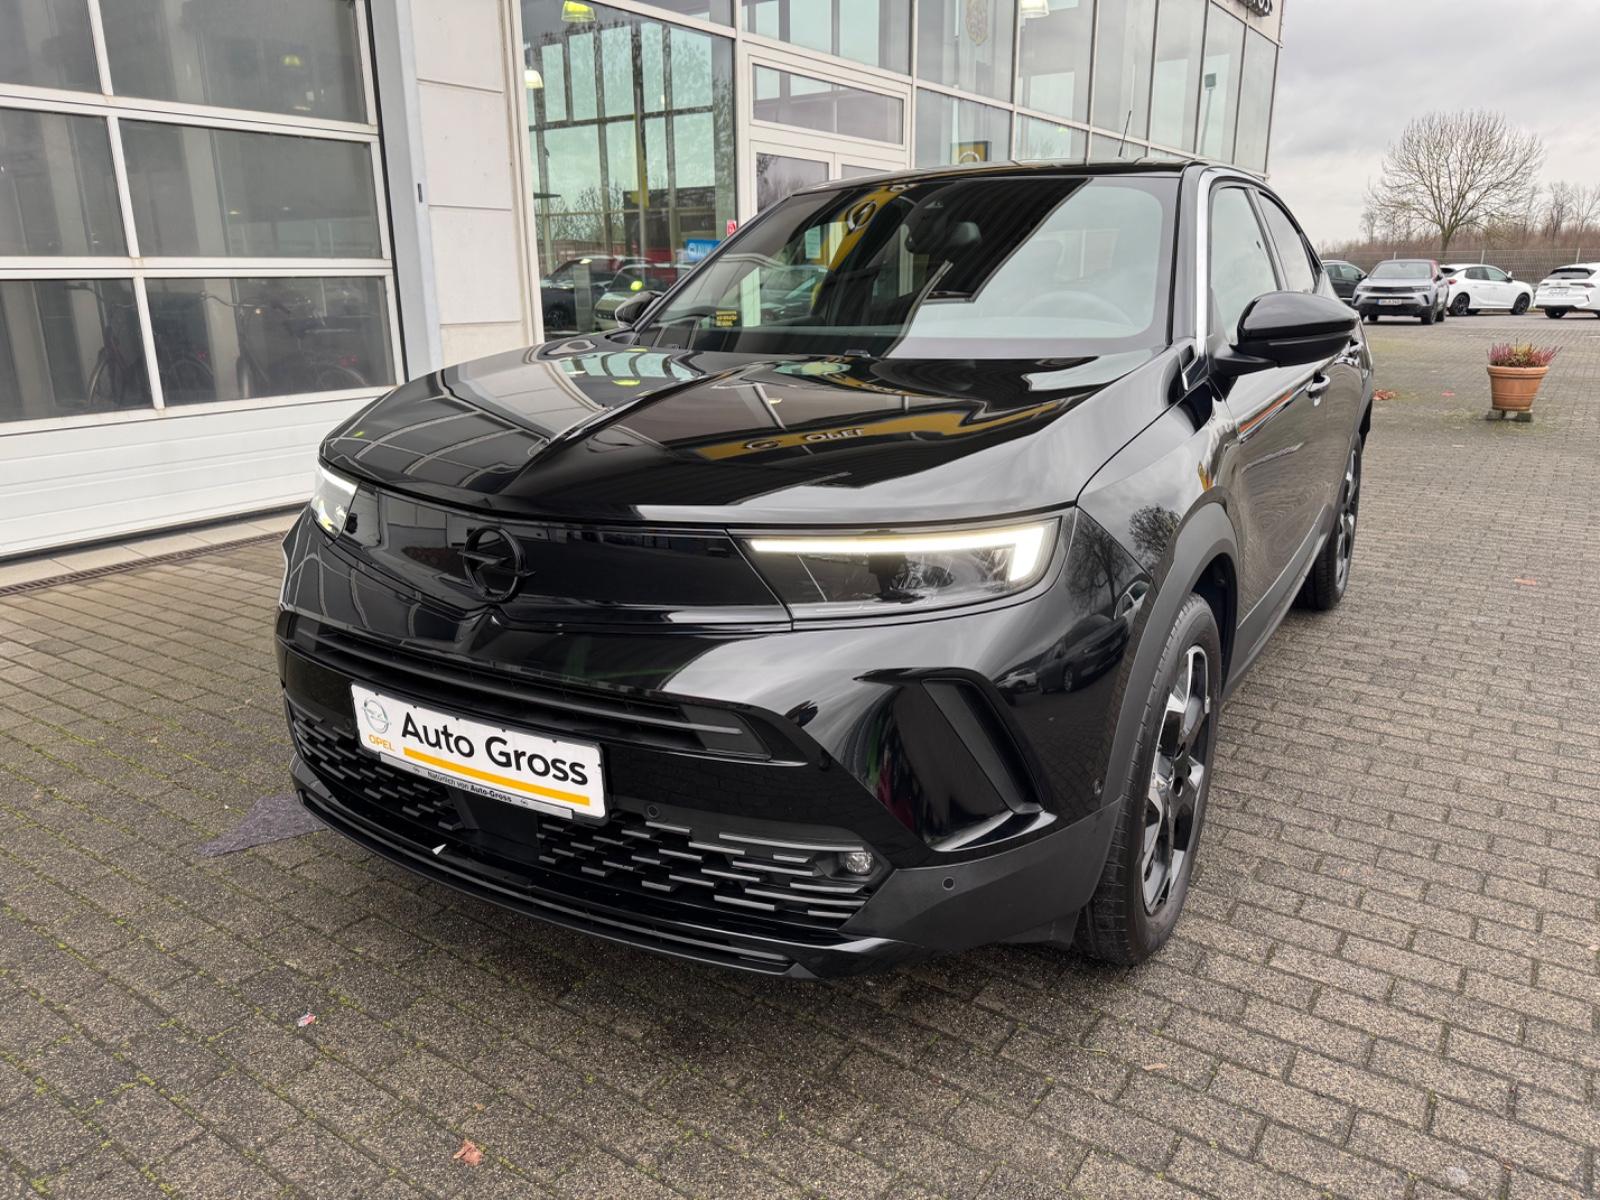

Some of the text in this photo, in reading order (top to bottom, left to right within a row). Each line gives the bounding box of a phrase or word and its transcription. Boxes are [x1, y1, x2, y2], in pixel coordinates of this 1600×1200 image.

[368, 735, 396, 752] OPEL
[401, 711, 588, 786] Auto Gross
[456, 781, 469, 790] von
[470, 785, 512, 802] Auto-Gross
